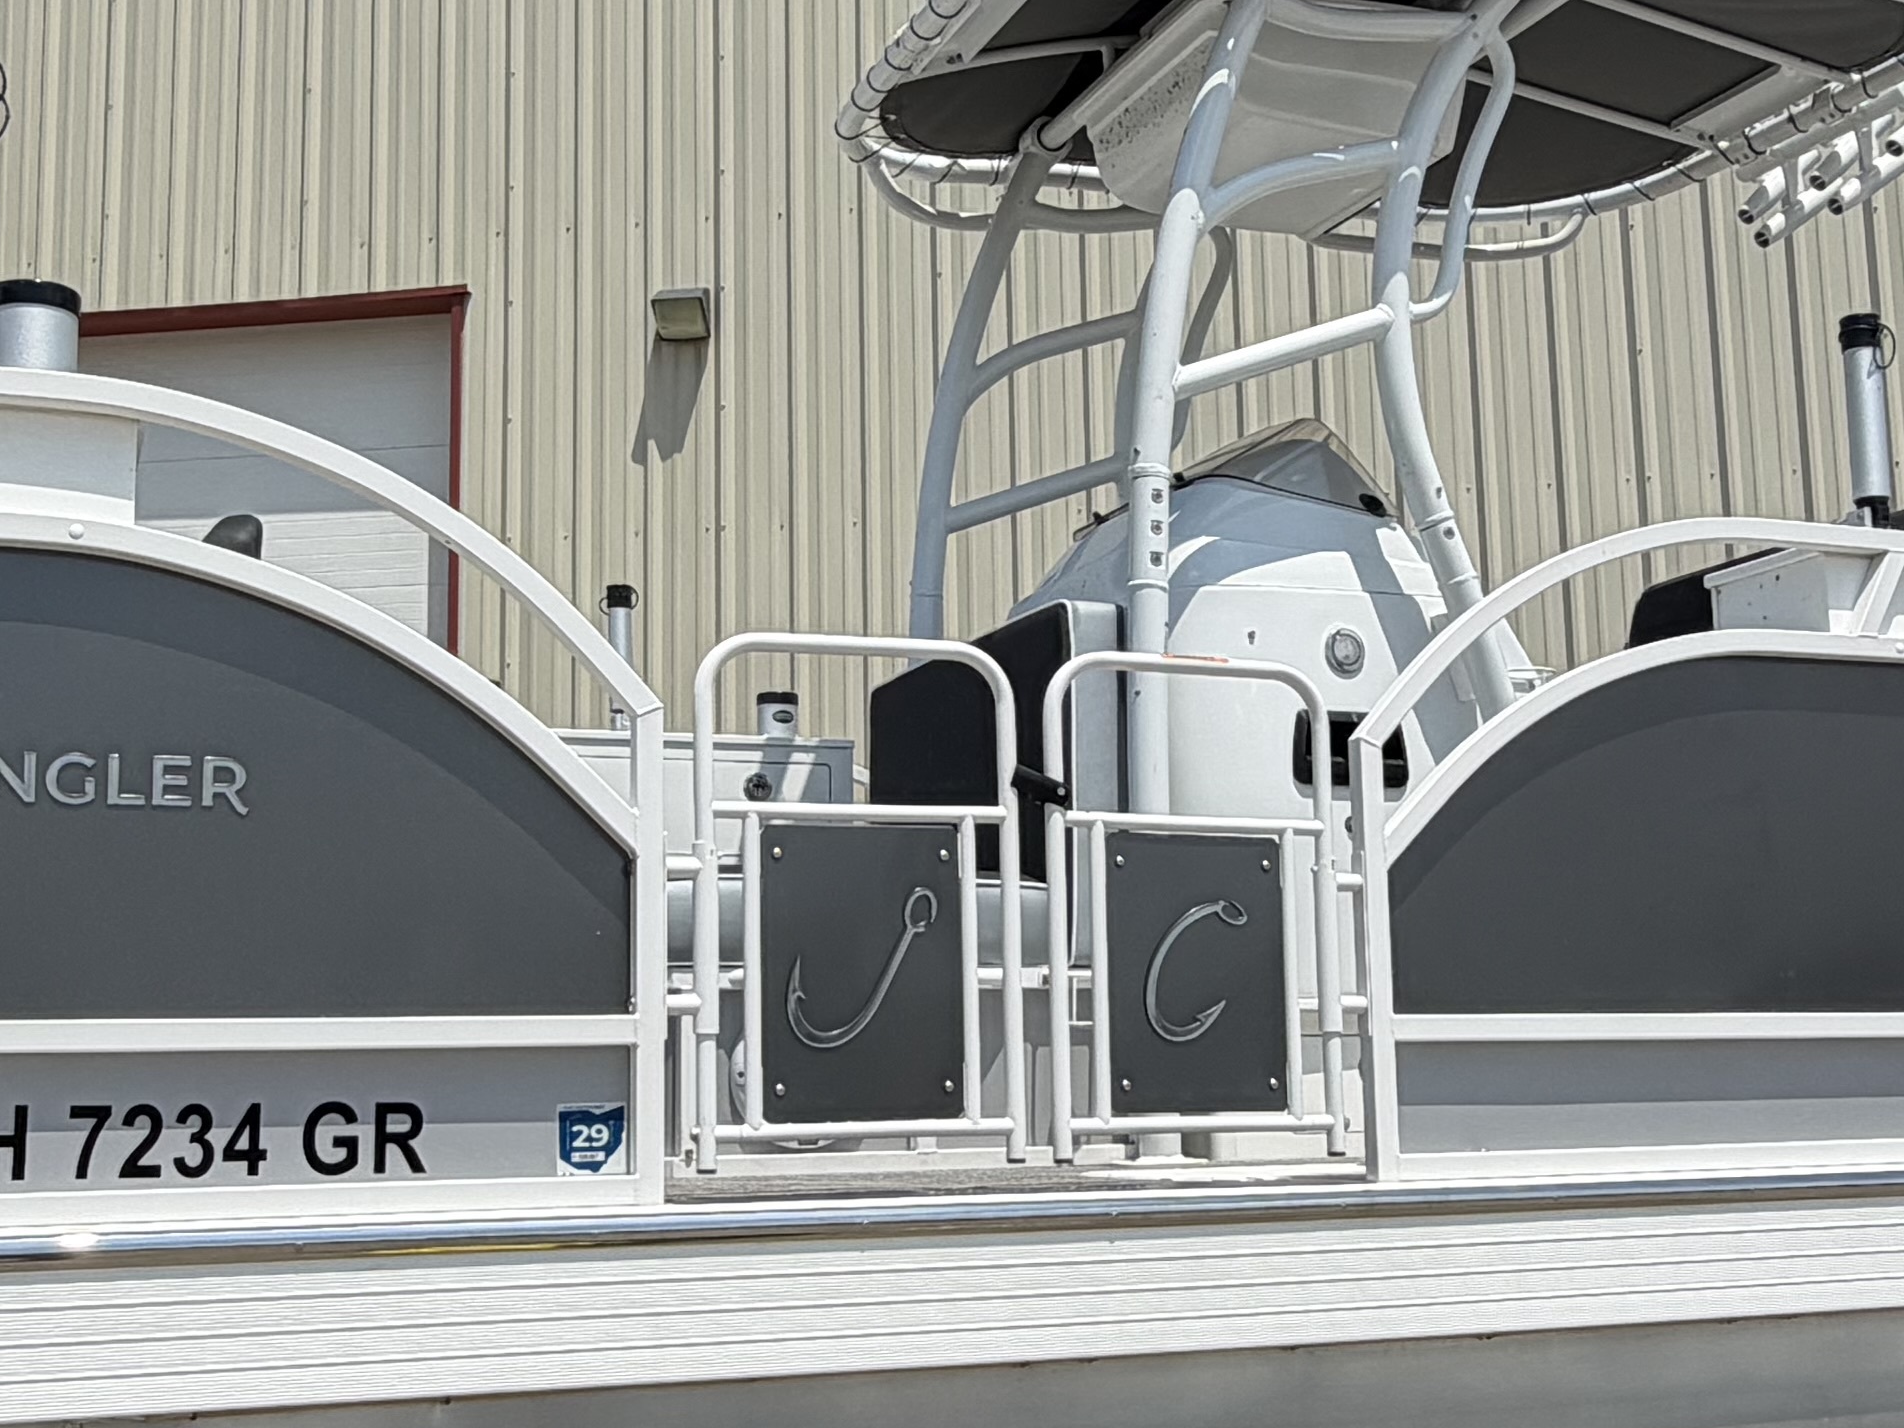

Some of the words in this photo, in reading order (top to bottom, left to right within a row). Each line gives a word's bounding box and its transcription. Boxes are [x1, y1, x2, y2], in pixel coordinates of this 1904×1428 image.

[68, 1102, 268, 1180] 7234
[302, 1101, 429, 1176] GR
[571, 1123, 610, 1147] 29
